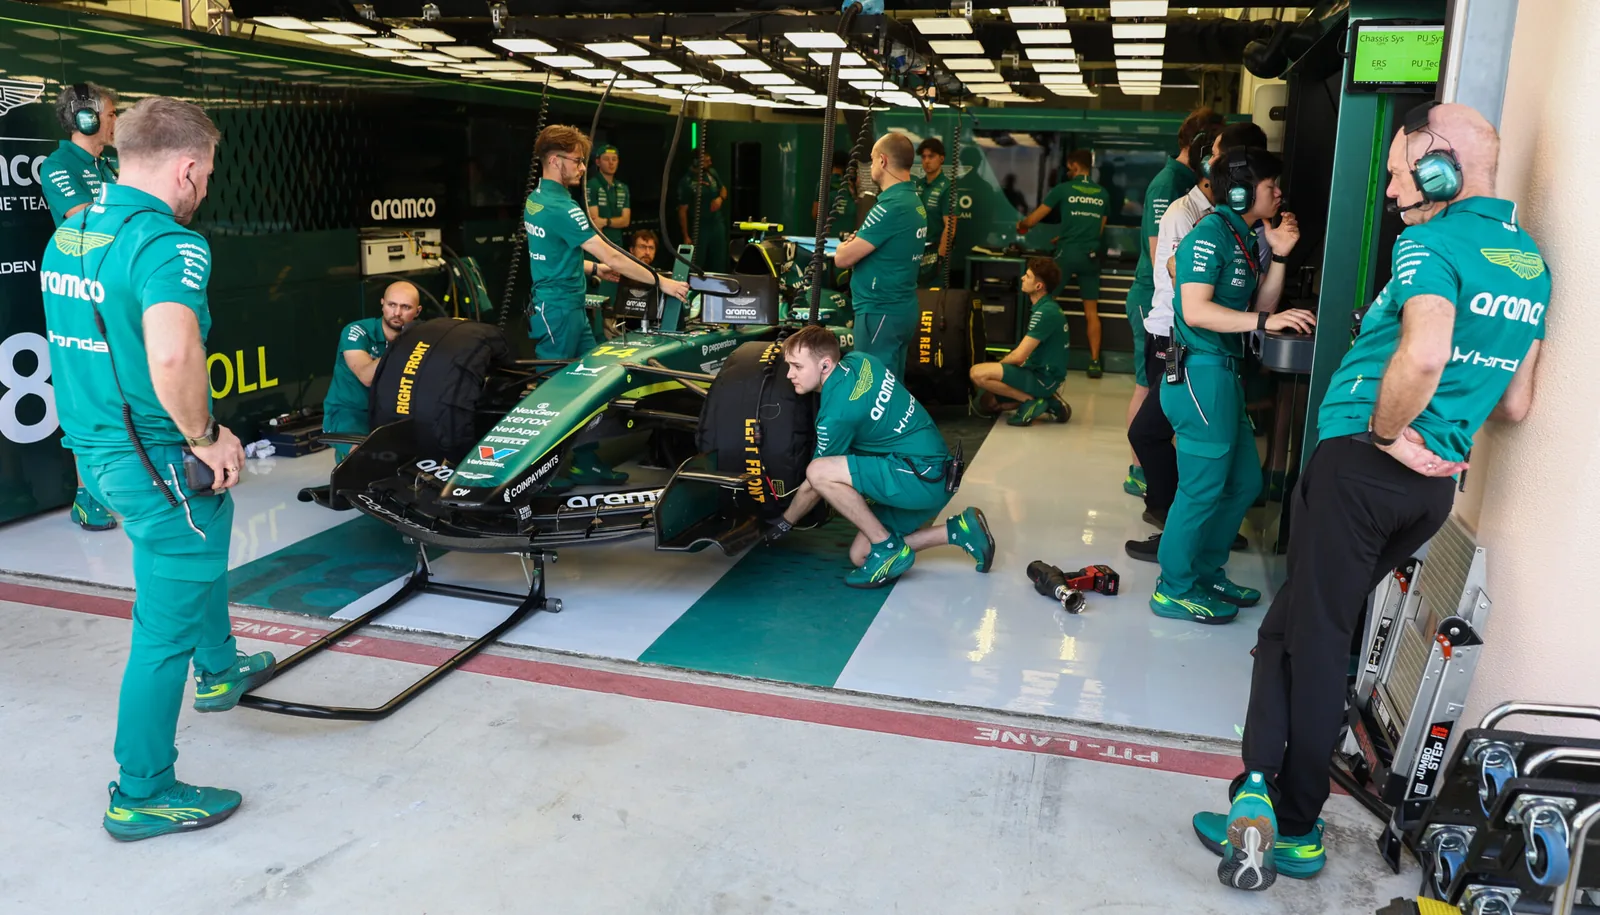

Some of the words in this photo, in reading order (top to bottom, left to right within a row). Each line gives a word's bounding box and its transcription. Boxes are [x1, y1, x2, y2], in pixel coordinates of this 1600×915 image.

[1359, 34, 1389, 43] Chassis
[1391, 34, 1405, 44] Sys
[1417, 34, 1429, 42] PU
[1371, 59, 1387, 68] ERS
[1411, 59, 1424, 67] PU
[20, 196, 50, 211] TEA
[1068, 195, 1104, 206] aramco
[371, 197, 436, 221] aramco
[0, 260, 37, 274] DEN
[40, 270, 106, 304] ramco
[725, 308, 757, 317] aramco
[920, 310, 933, 334] LEFT
[708, 338, 762, 357] pepperstone
[839, 333, 855, 348] BO
[591, 345, 640, 359] 14
[919, 336, 932, 364] REAR
[403, 341, 430, 375] FRONT
[206, 345, 279, 399] OLL
[396, 376, 414, 415] RIGHT
[511, 406, 561, 417] NexGen
[503, 415, 552, 427] xerox
[491, 425, 540, 437] NetApp
[483, 435, 530, 446] PIRELLI
[510, 454, 560, 498] COINPAYMENTS
[973, 726, 1160, 764] PIT-LANE
[1414, 747, 1434, 780] JUMBO
[1427, 741, 1445, 772] STEP
